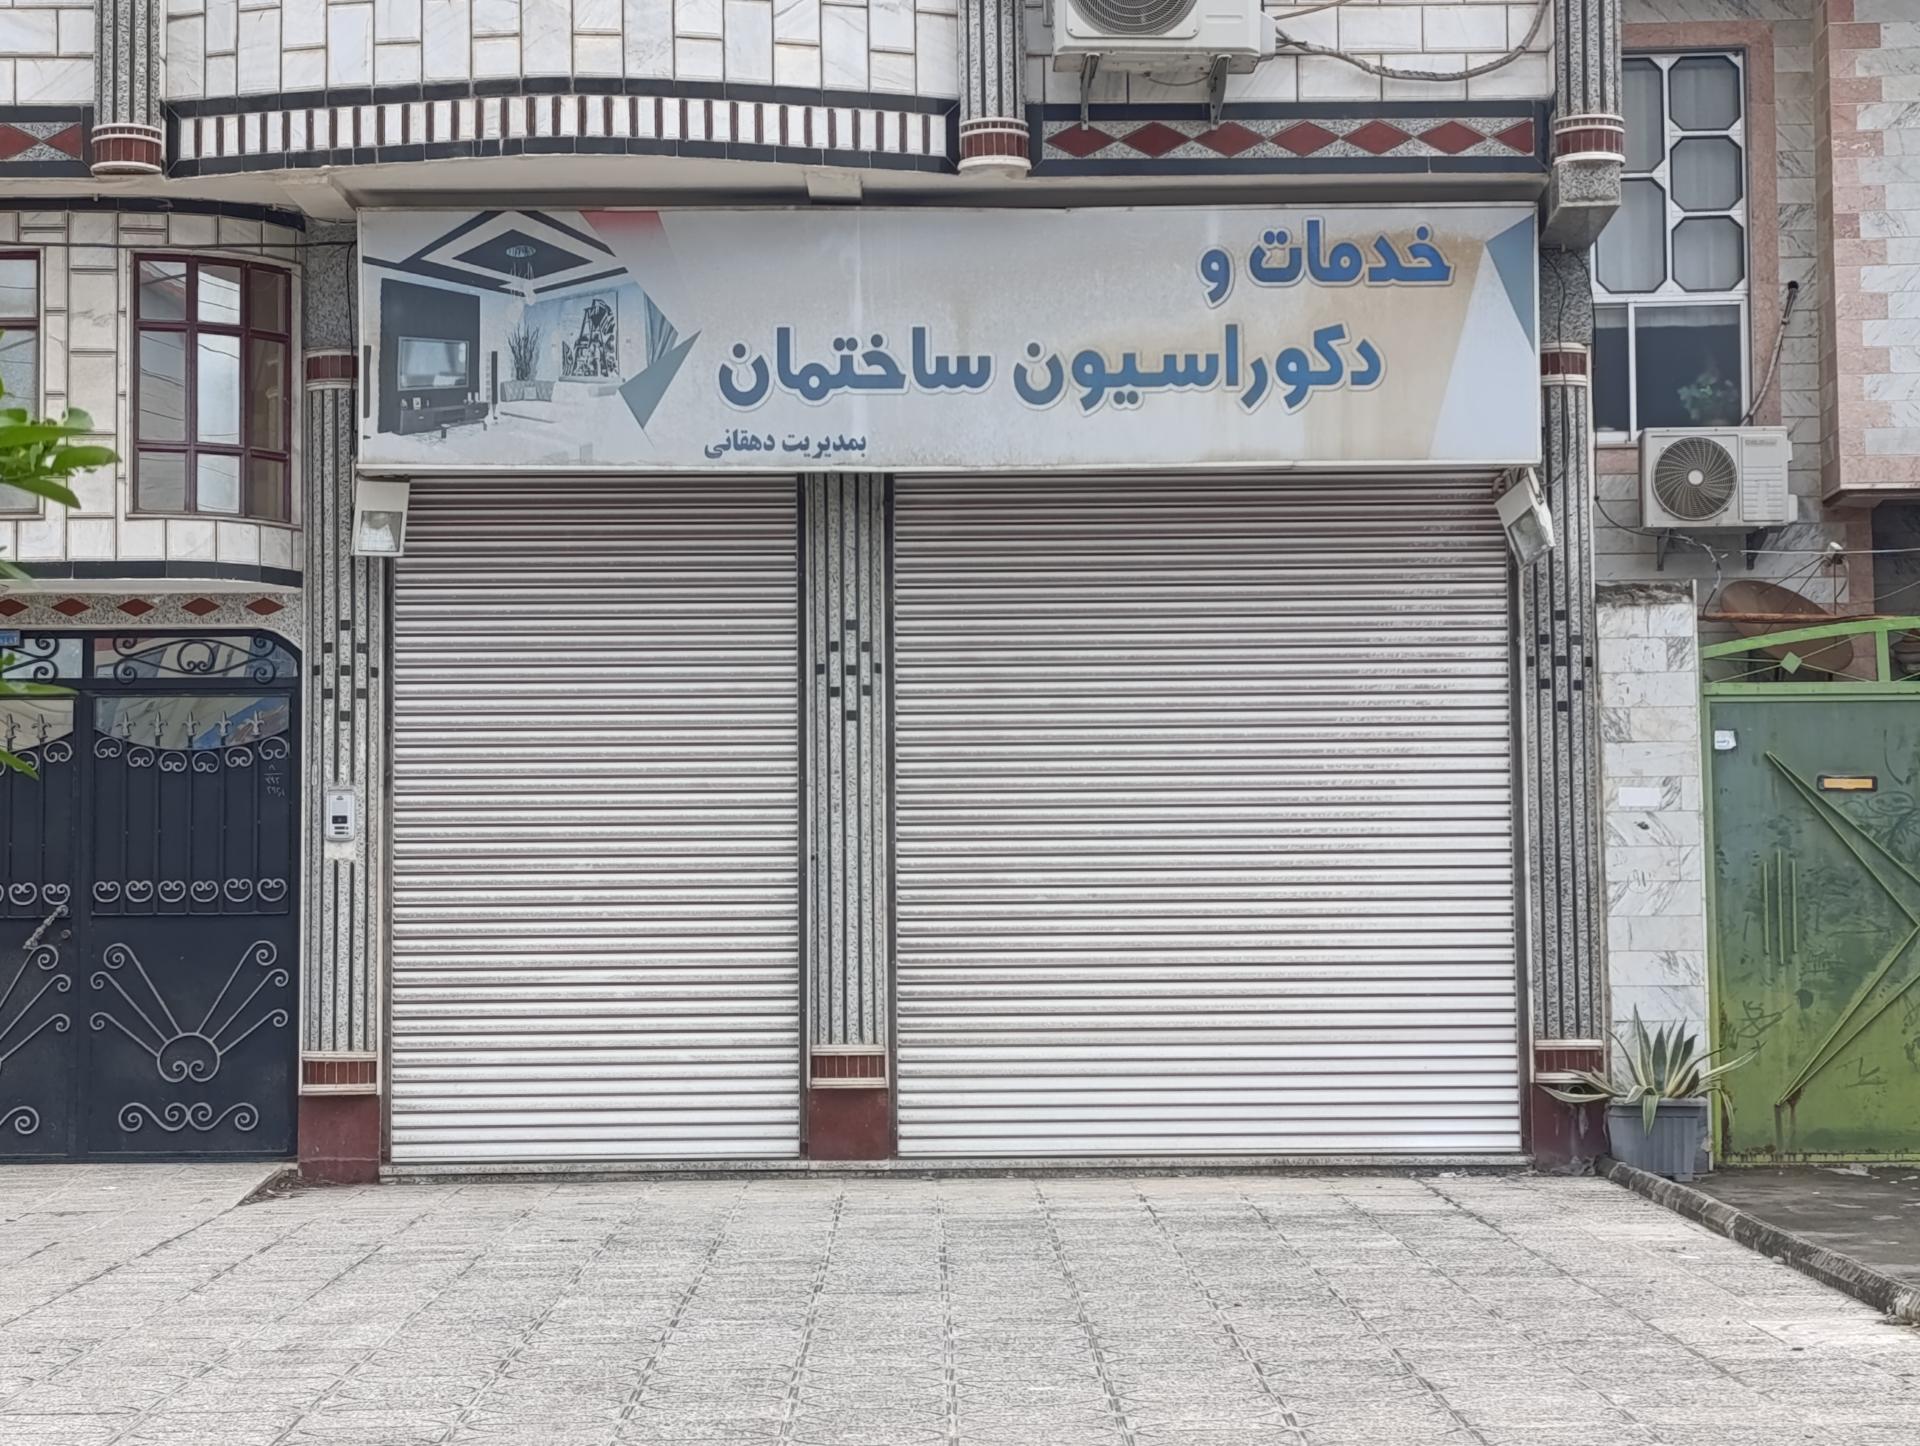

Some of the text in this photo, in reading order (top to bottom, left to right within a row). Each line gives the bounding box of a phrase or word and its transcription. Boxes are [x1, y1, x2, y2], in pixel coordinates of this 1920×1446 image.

[1200, 217, 1452, 303] خدمات و
[718, 323, 1384, 411] دکوراسیون ساختمان
[703, 427, 867, 460] بمدیریت دهقانی
